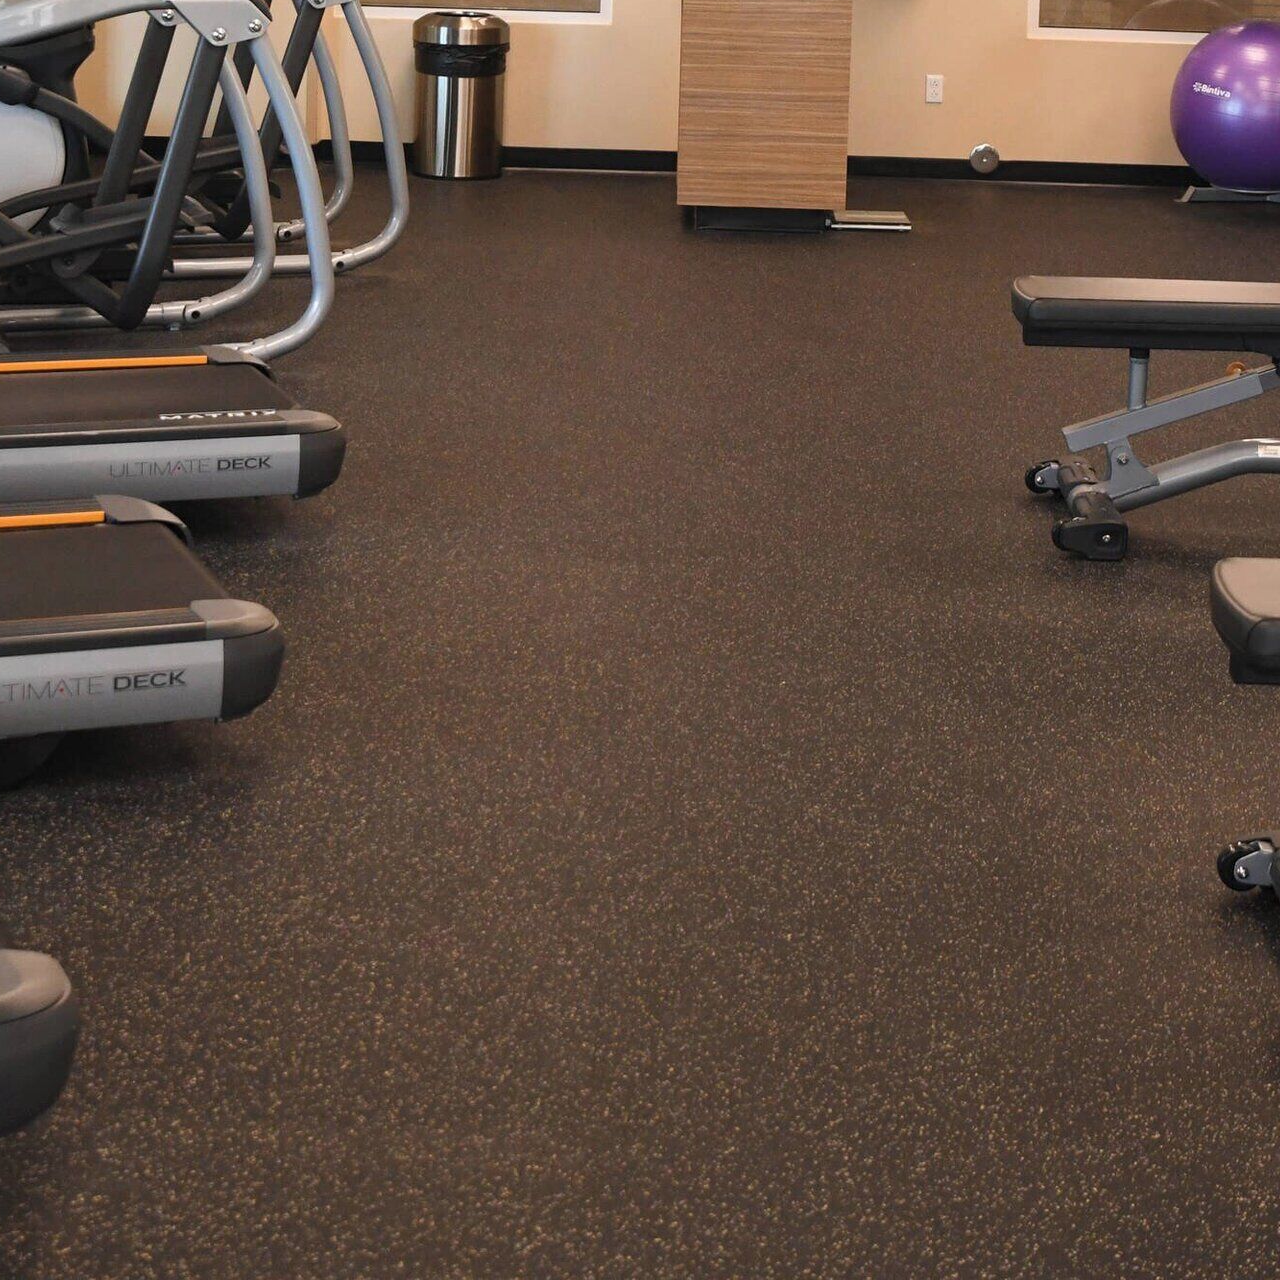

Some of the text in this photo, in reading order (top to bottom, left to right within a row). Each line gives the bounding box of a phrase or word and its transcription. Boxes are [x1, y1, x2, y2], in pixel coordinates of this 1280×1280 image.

[1201, 83, 1231, 98] Bintiva
[160, 408, 276, 420] MATRIX
[109, 456, 273, 478] ULTIMATE DECK
[113, 670, 186, 691] DECK
